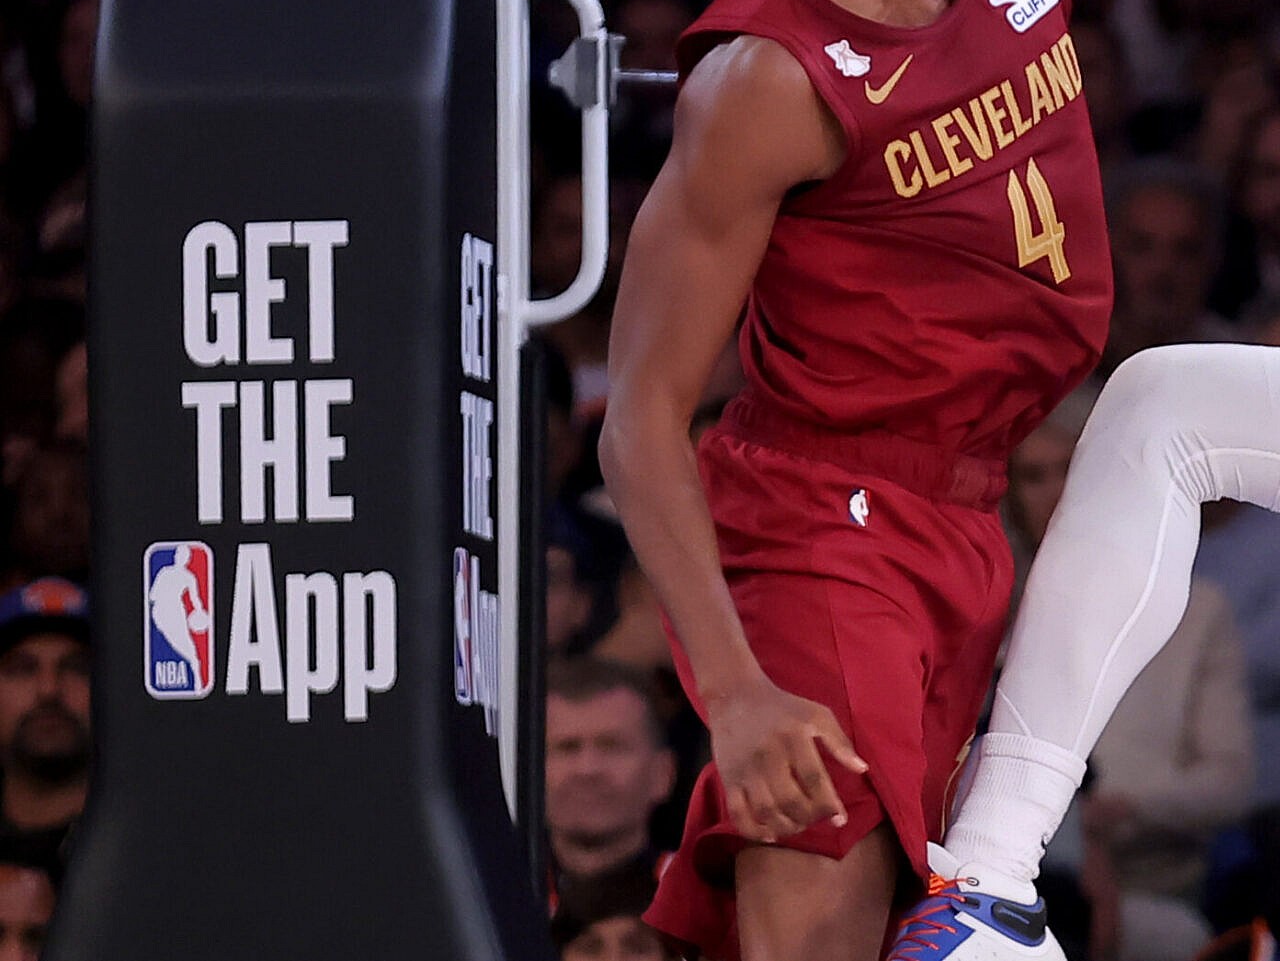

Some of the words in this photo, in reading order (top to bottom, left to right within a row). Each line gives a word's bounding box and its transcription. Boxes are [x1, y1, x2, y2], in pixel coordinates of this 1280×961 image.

[884, 33, 1083, 198] CLEVELAND
[182, 219, 349, 368] GET
[1006, 156, 1072, 285] 4
[180, 378, 354, 525] THE
[155, 660, 188, 689] NBA
[225, 542, 398, 724] App
